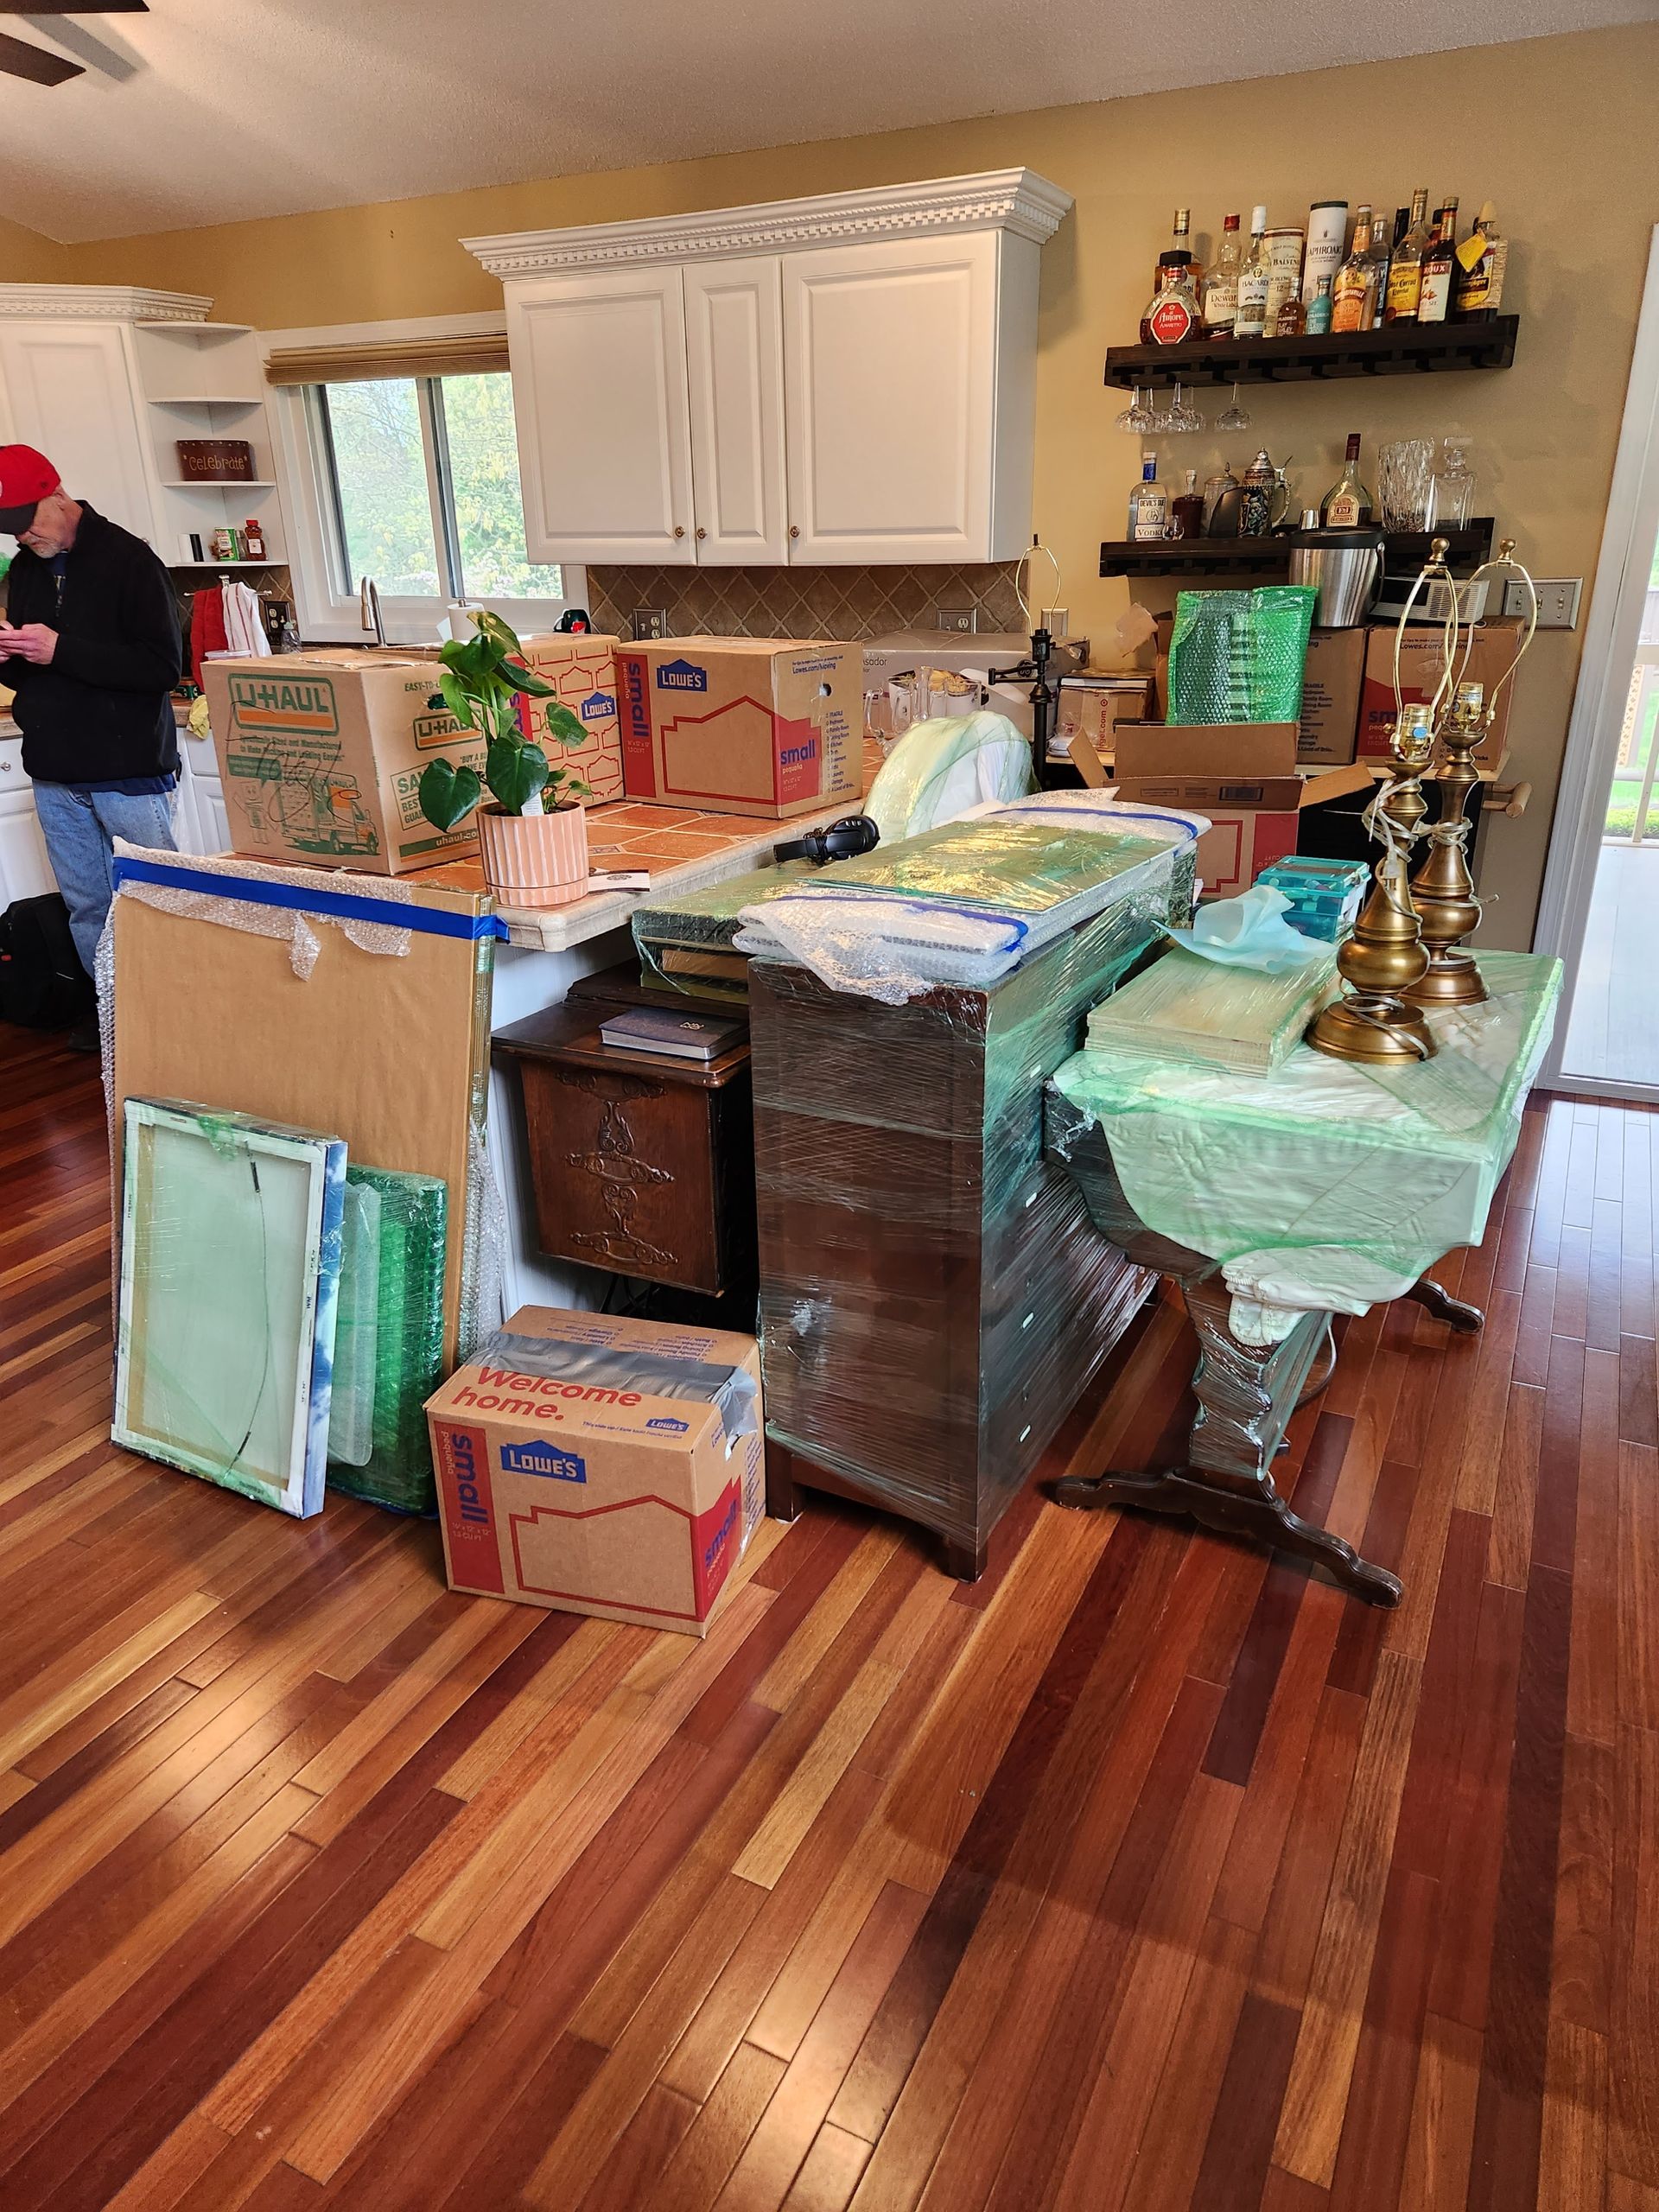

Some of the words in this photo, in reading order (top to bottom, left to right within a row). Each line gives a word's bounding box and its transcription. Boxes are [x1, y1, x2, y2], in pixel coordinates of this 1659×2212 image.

[863, 657, 887, 666] sador
[662, 671, 702, 688] LOWE'S
[236, 683, 329, 712] U-HAUL
[584, 700, 613, 717] LOWE'S
[628, 663, 650, 737] small
[418, 718, 468, 737] U-HA
[780, 739, 816, 765] small
[402, 798, 420, 812] BES
[477, 1366, 642, 1407] Welcome
[451, 1386, 564, 1421] home.
[651, 1420, 684, 1431] LOWE'S
[442, 1430, 454, 1474] pequeña
[509, 1449, 578, 1478] LOWE'S
[452, 1433, 488, 1524] small
